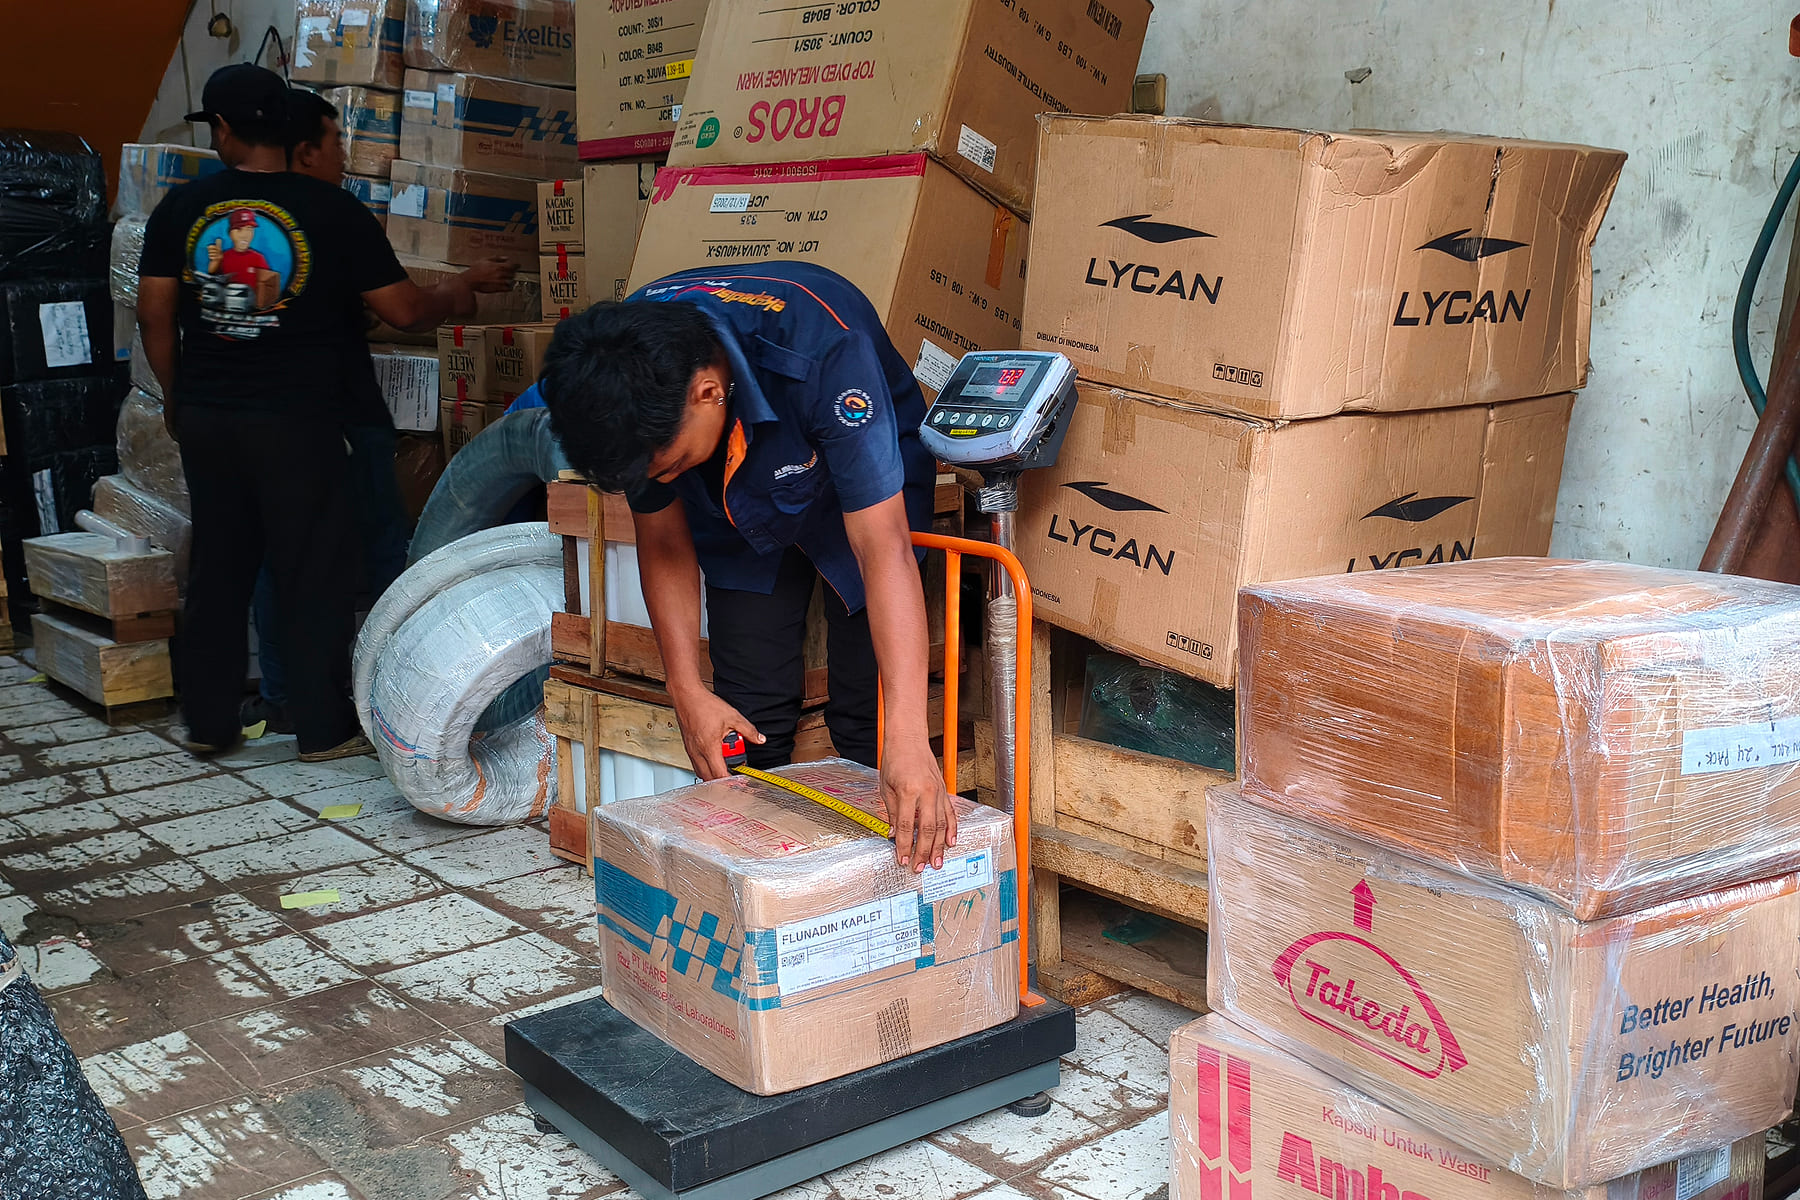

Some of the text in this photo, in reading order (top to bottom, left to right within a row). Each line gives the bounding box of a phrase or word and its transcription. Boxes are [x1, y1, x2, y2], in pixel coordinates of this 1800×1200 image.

[802, 0, 881, 24] COLOR: B04B
[502, 20, 573, 50] Exeltis
[618, 22, 644, 37] COUNT:
[794, 29, 873, 53] COUNT: 30S/1
[618, 49, 645, 62] COLOR:
[984, 43, 1018, 78] INDUSTRY
[1057, 40, 1073, 59] LBS
[619, 76, 633, 87] LOT.
[634, 73, 646, 85] NO:
[736, 60, 876, 91] TOP DYED MELANGE YARN
[1017, 69, 1043, 100] TEXTILE
[619, 102, 633, 112] CTN.
[635, 100, 646, 110] NO:
[746, 95, 846, 144] BROS
[545, 197, 574, 209] KACANG
[546, 209, 575, 225] METE
[783, 211, 802, 223] NO:
[807, 210, 828, 222] CTN.
[776, 241, 795, 254] NO:
[799, 240, 819, 253] LOT.
[548, 271, 577, 281] KANG
[930, 268, 948, 287] LBS
[1084, 257, 1224, 305] LYCAN
[549, 283, 578, 298] METE
[951, 281, 964, 296] 108
[994, 306, 1009, 323] LBS
[1393, 288, 1531, 326] LYCAN
[914, 312, 954, 341] INDUSTRY
[1035, 331, 1058, 344] DIBUAT
[1065, 338, 1100, 353] INDONESIA
[448, 355, 476, 371] METE
[495, 360, 524, 377] METE
[1047, 513, 1176, 576] LYCAN
[782, 909, 883, 946] FLUNADIN KAPLET
[642, 959, 668, 984] IFARS
[1303, 959, 1431, 1054] Takeda
[1619, 970, 1775, 1036] Better Health,
[685, 1002, 736, 1041] Laboratories
[1616, 1015, 1791, 1083] Brighter Future
[1322, 1106, 1491, 1180] Kapsul Untuk Wasir
[1277, 1131, 1432, 1200] Amb
